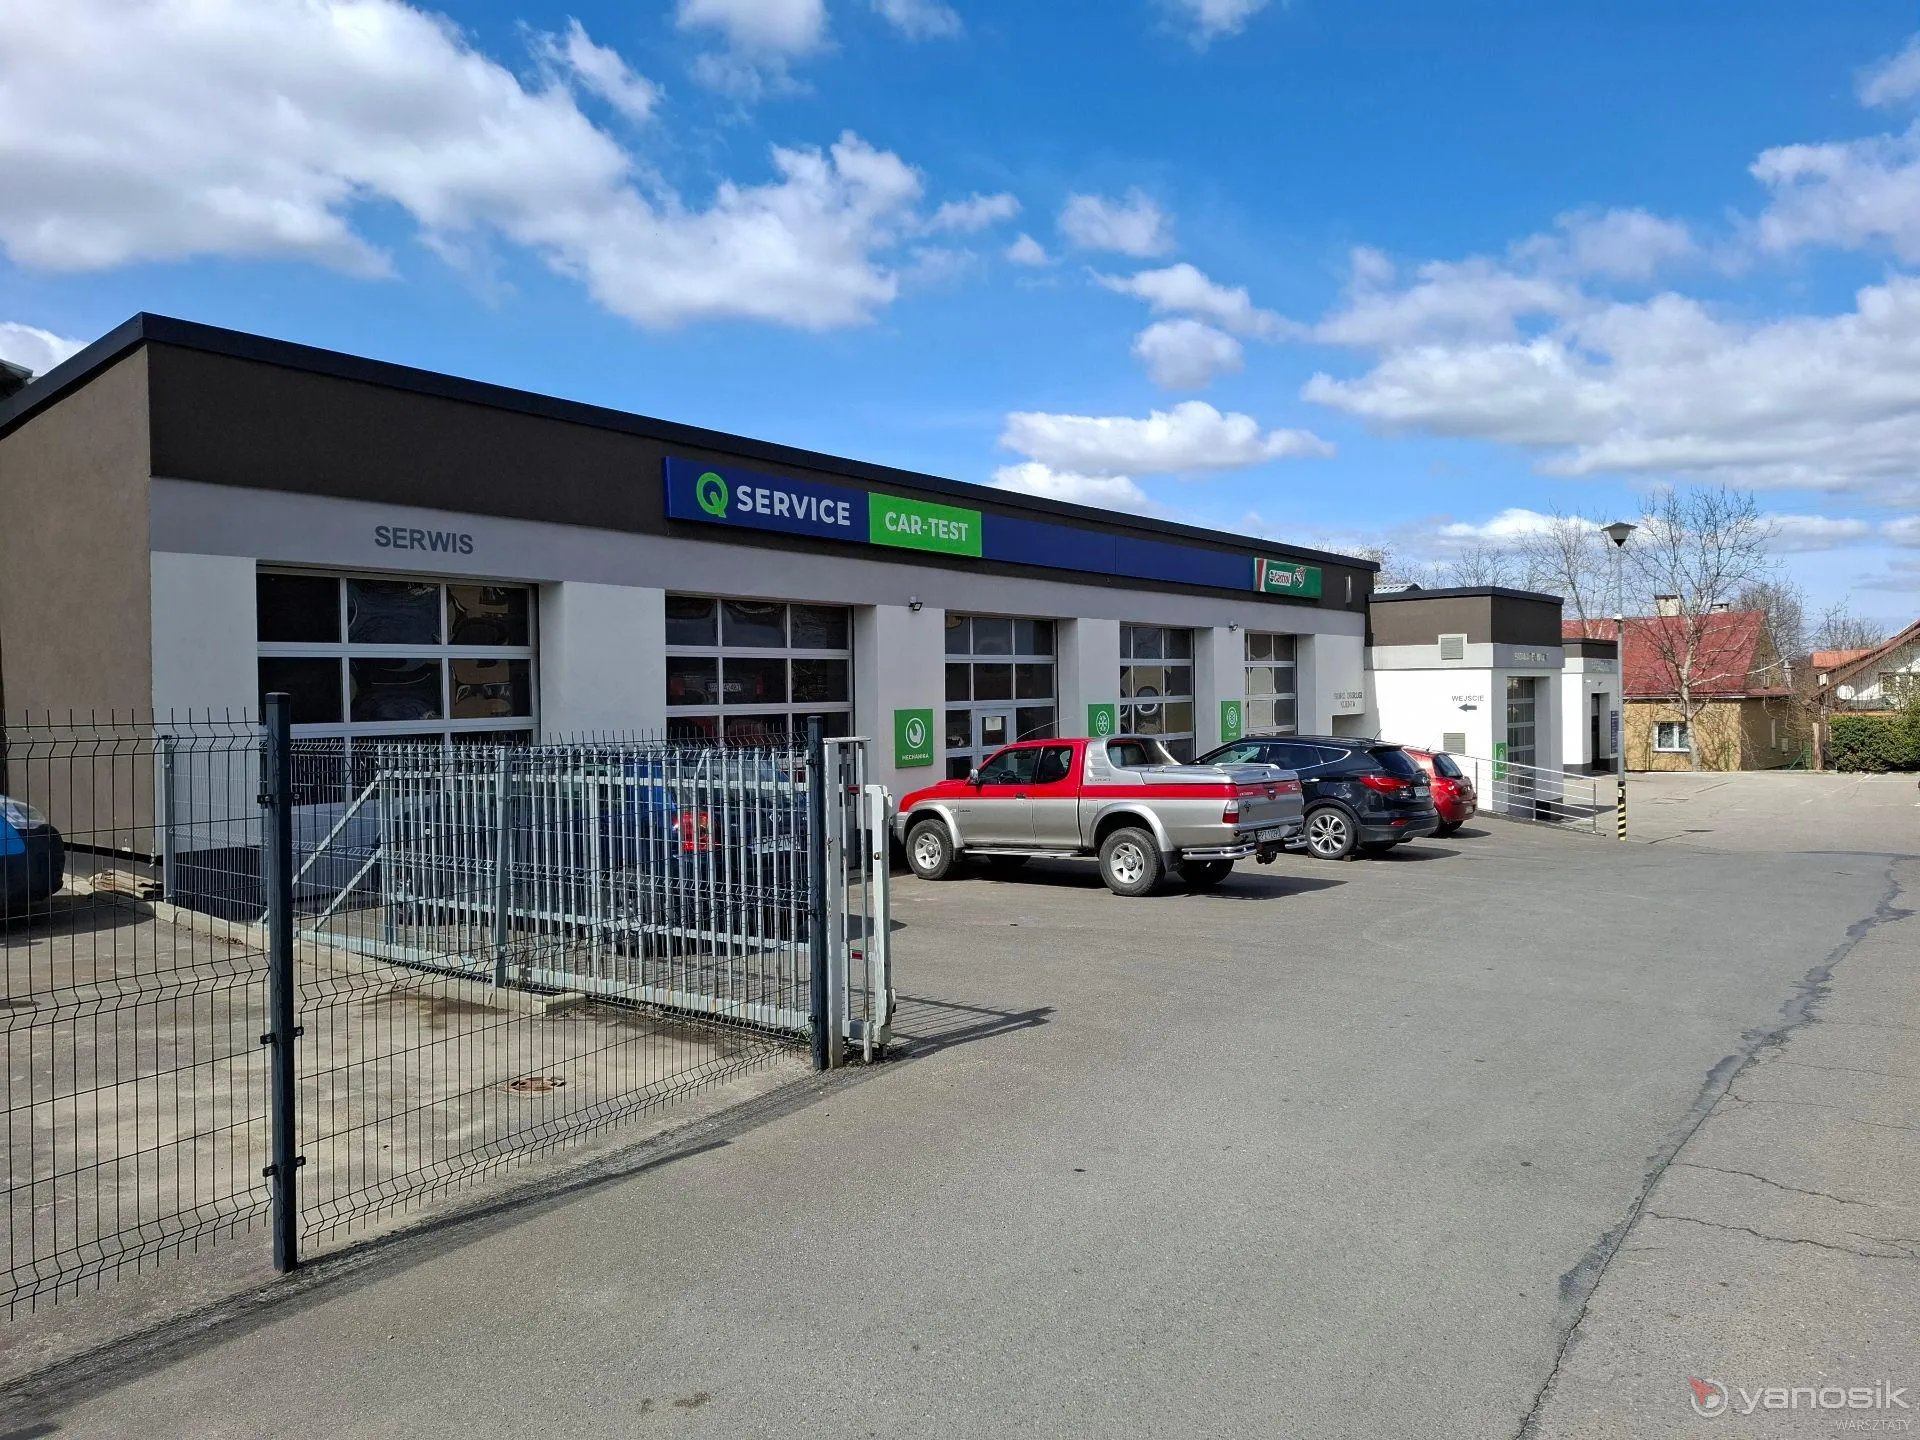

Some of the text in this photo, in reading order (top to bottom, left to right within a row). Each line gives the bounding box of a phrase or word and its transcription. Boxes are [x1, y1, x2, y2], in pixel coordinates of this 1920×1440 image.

[697, 472, 851, 526] Q SERVICE
[374, 525, 474, 555] SERWIS
[885, 511, 969, 542] CAR-TEST
